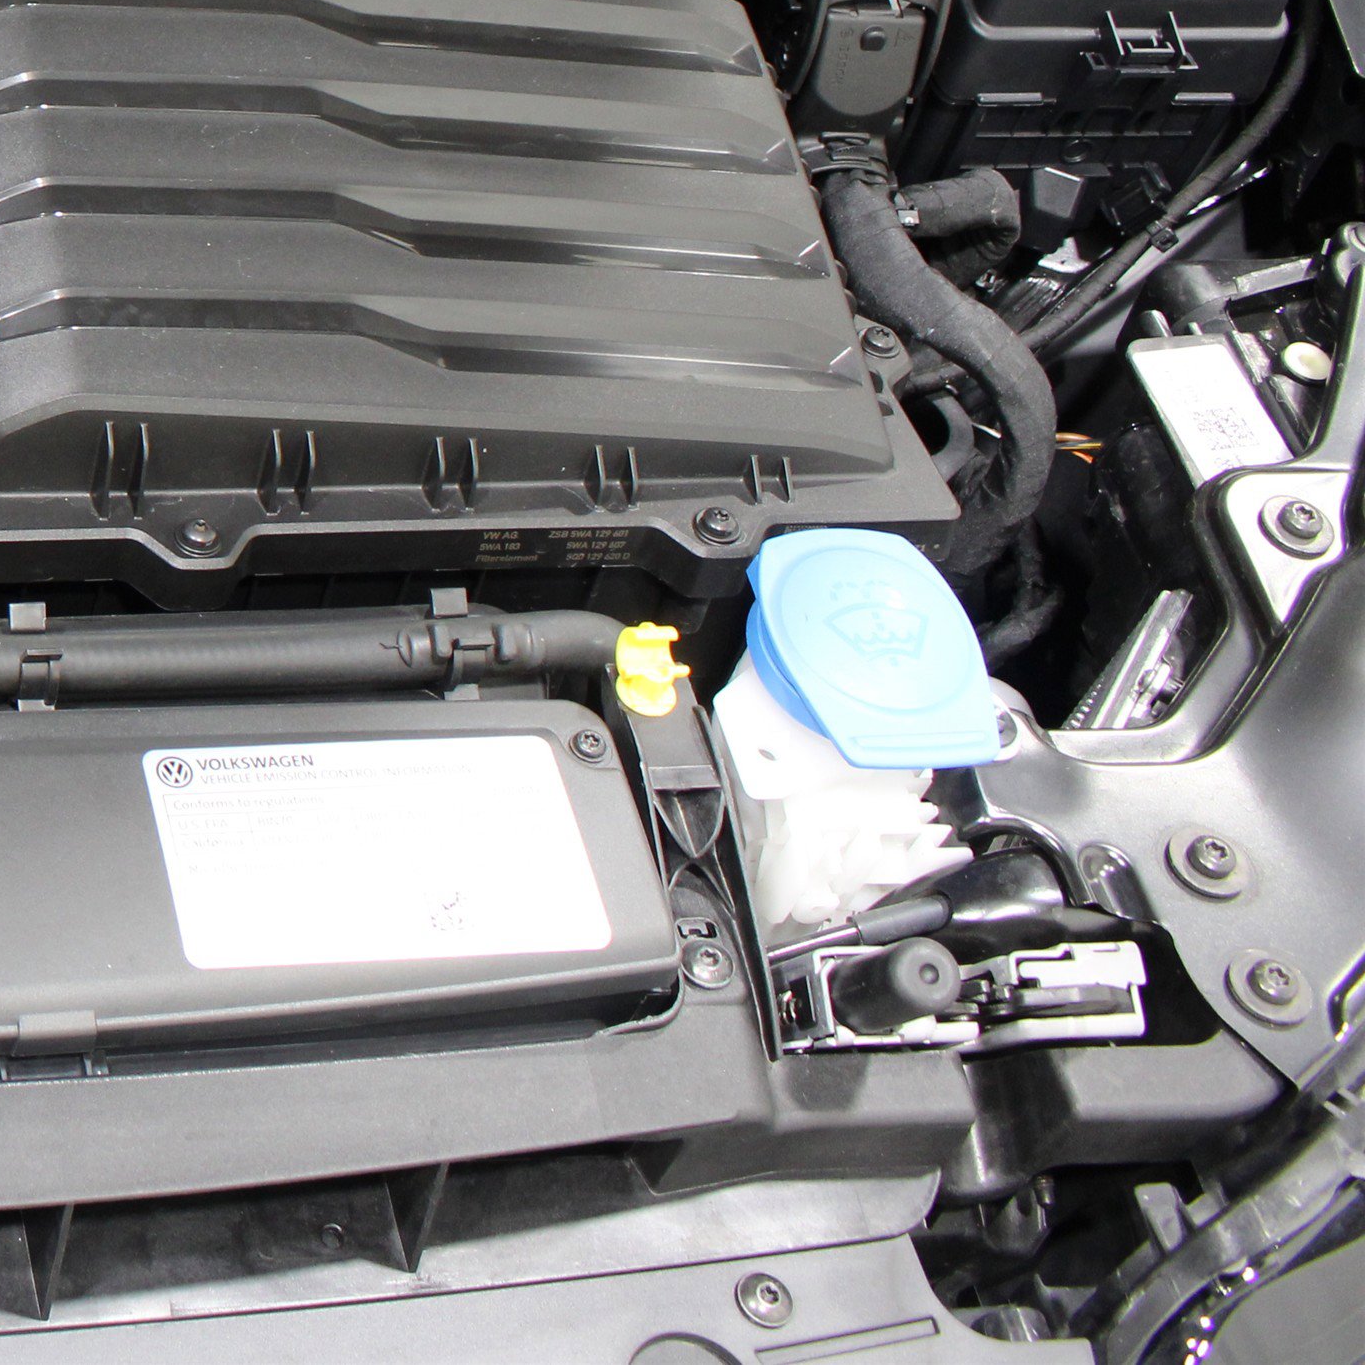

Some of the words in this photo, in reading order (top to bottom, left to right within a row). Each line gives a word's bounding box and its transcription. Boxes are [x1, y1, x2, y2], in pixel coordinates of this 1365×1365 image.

[196, 755, 314, 771] VOLKSWAGEN
[200, 774, 250, 784] VEHICLE
[256, 771, 317, 782] EMISSION
[321, 768, 376, 779] CONTROL
[382, 764, 473, 776] INFORMATION
[173, 799, 234, 811] Conforms
